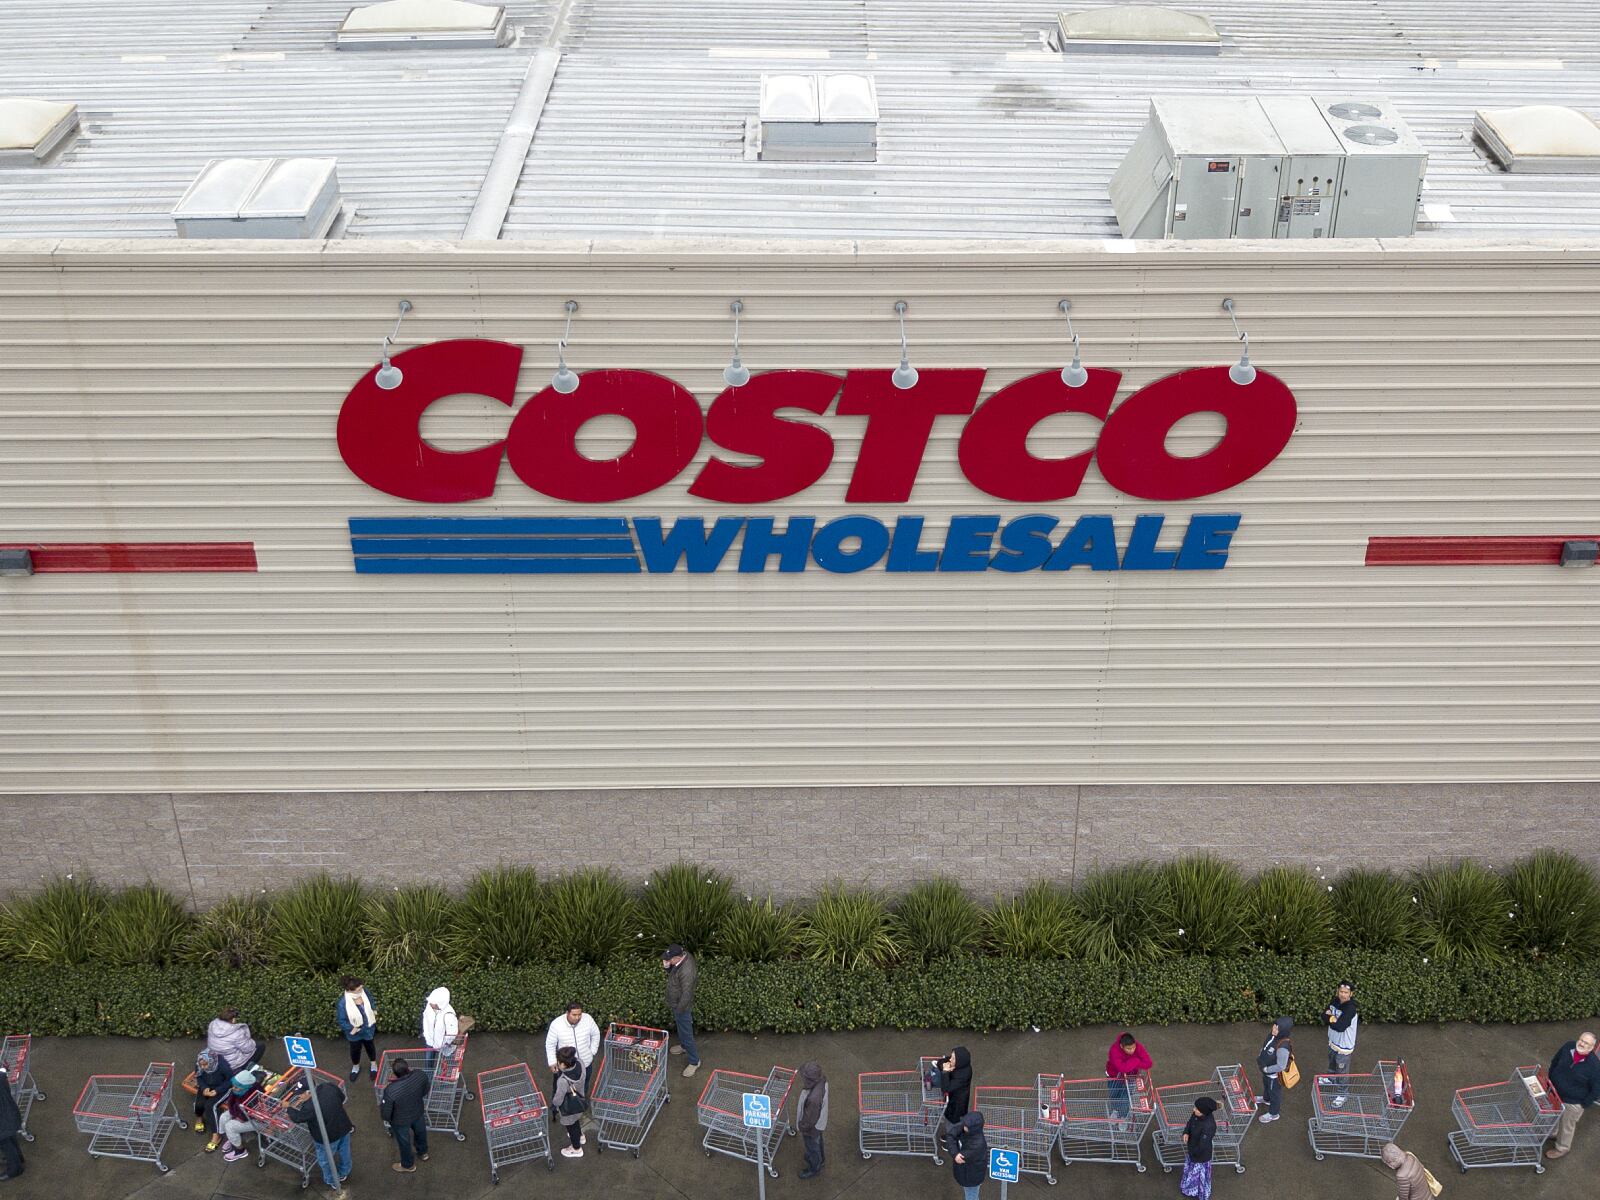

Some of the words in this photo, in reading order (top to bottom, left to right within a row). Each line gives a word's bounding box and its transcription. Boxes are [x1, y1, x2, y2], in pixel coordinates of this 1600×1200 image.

[337, 340, 1296, 503] COSTCO
[633, 513, 1241, 573] WHOLESALE
[746, 1110, 769, 1119] PARKING
[749, 1118, 766, 1126] ONLY
